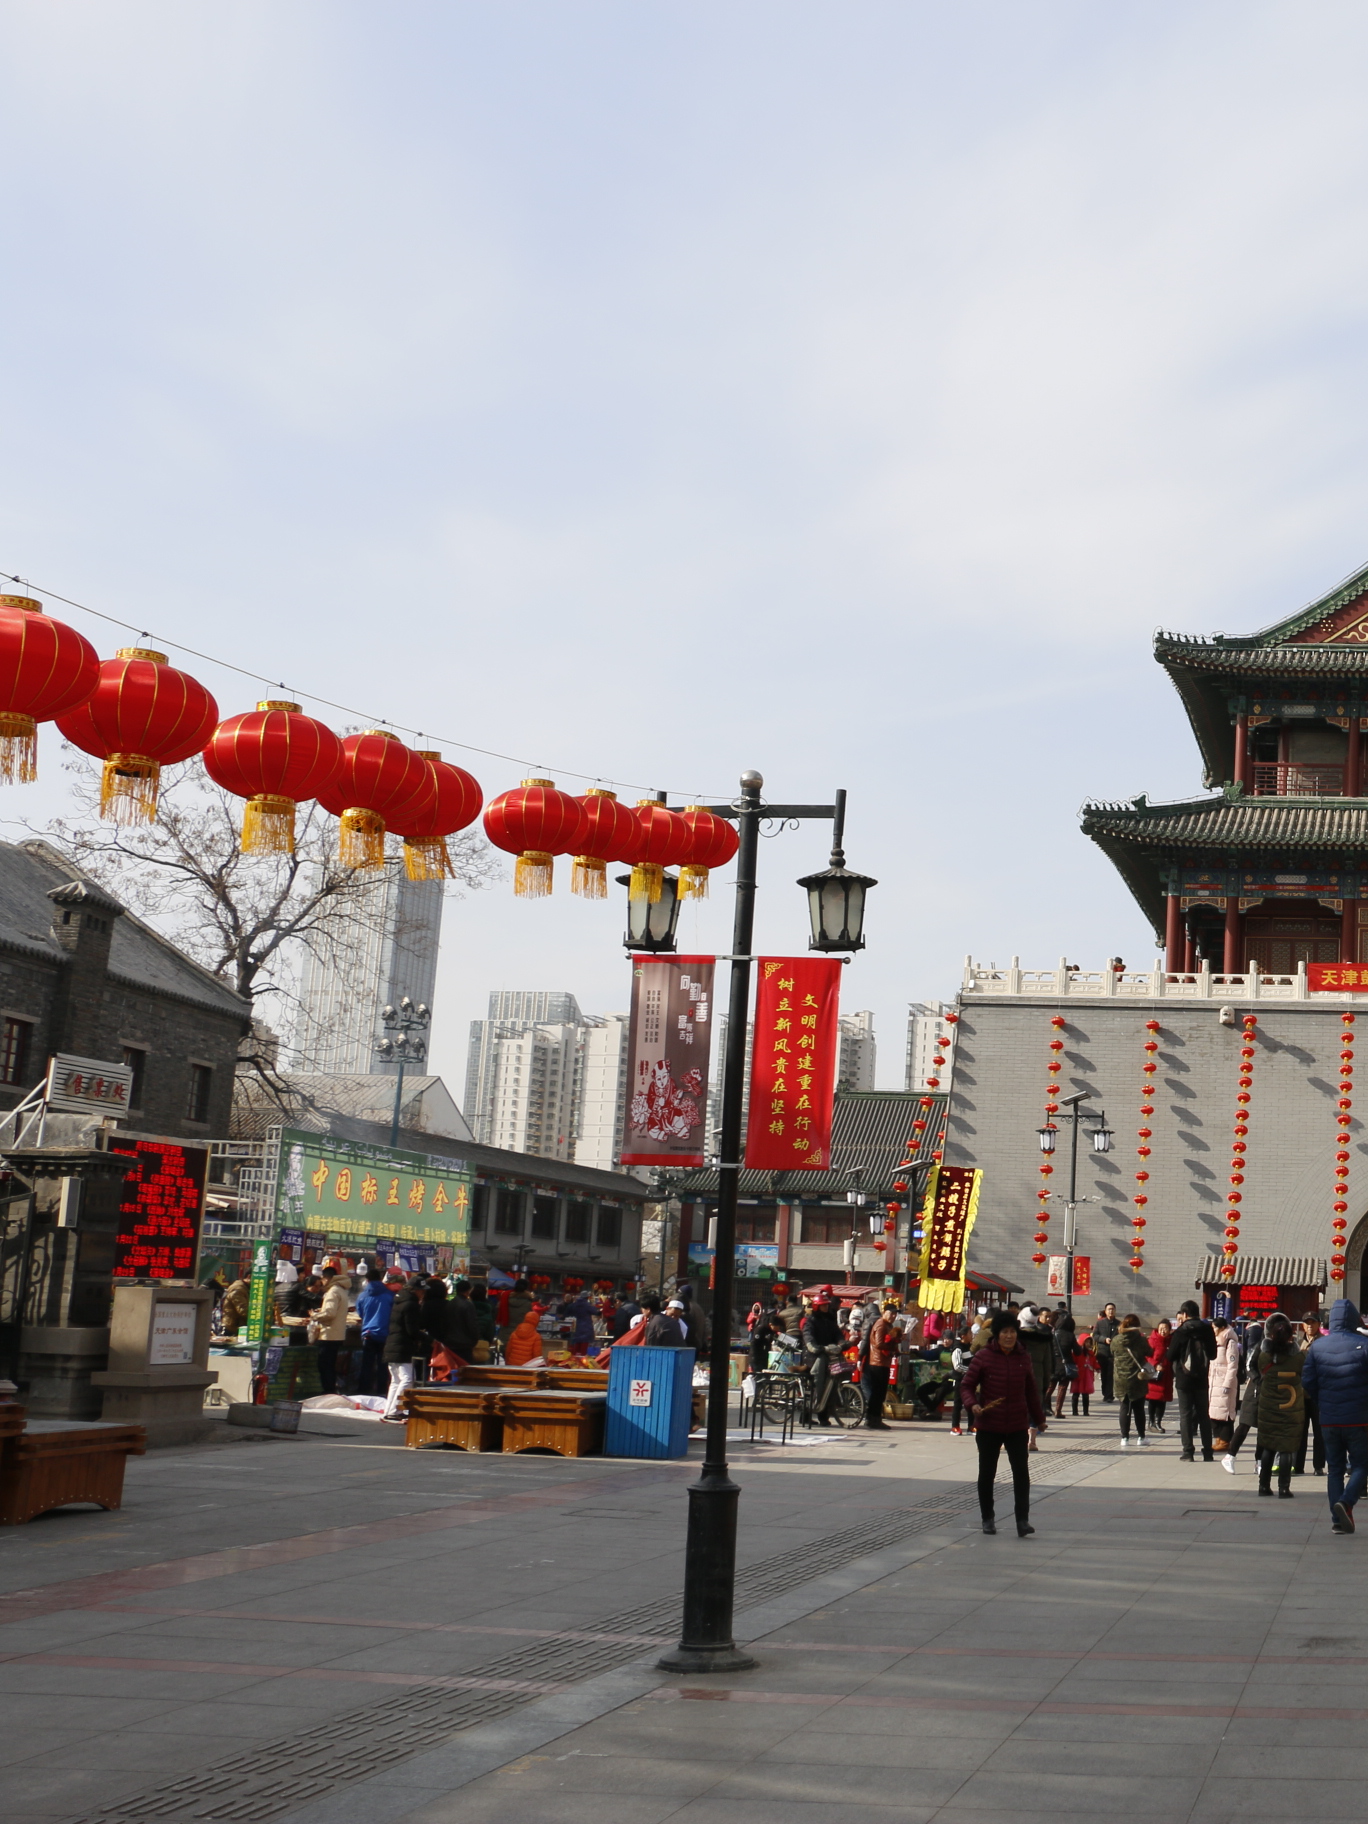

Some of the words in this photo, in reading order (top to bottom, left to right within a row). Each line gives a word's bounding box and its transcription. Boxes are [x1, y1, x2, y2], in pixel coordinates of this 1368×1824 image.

[768, 977, 795, 1136] 树立新风贵在坚持
[792, 993, 819, 1151] 文明创建重在行动
[312, 1158, 469, 1220] 中国标王烤全牛
